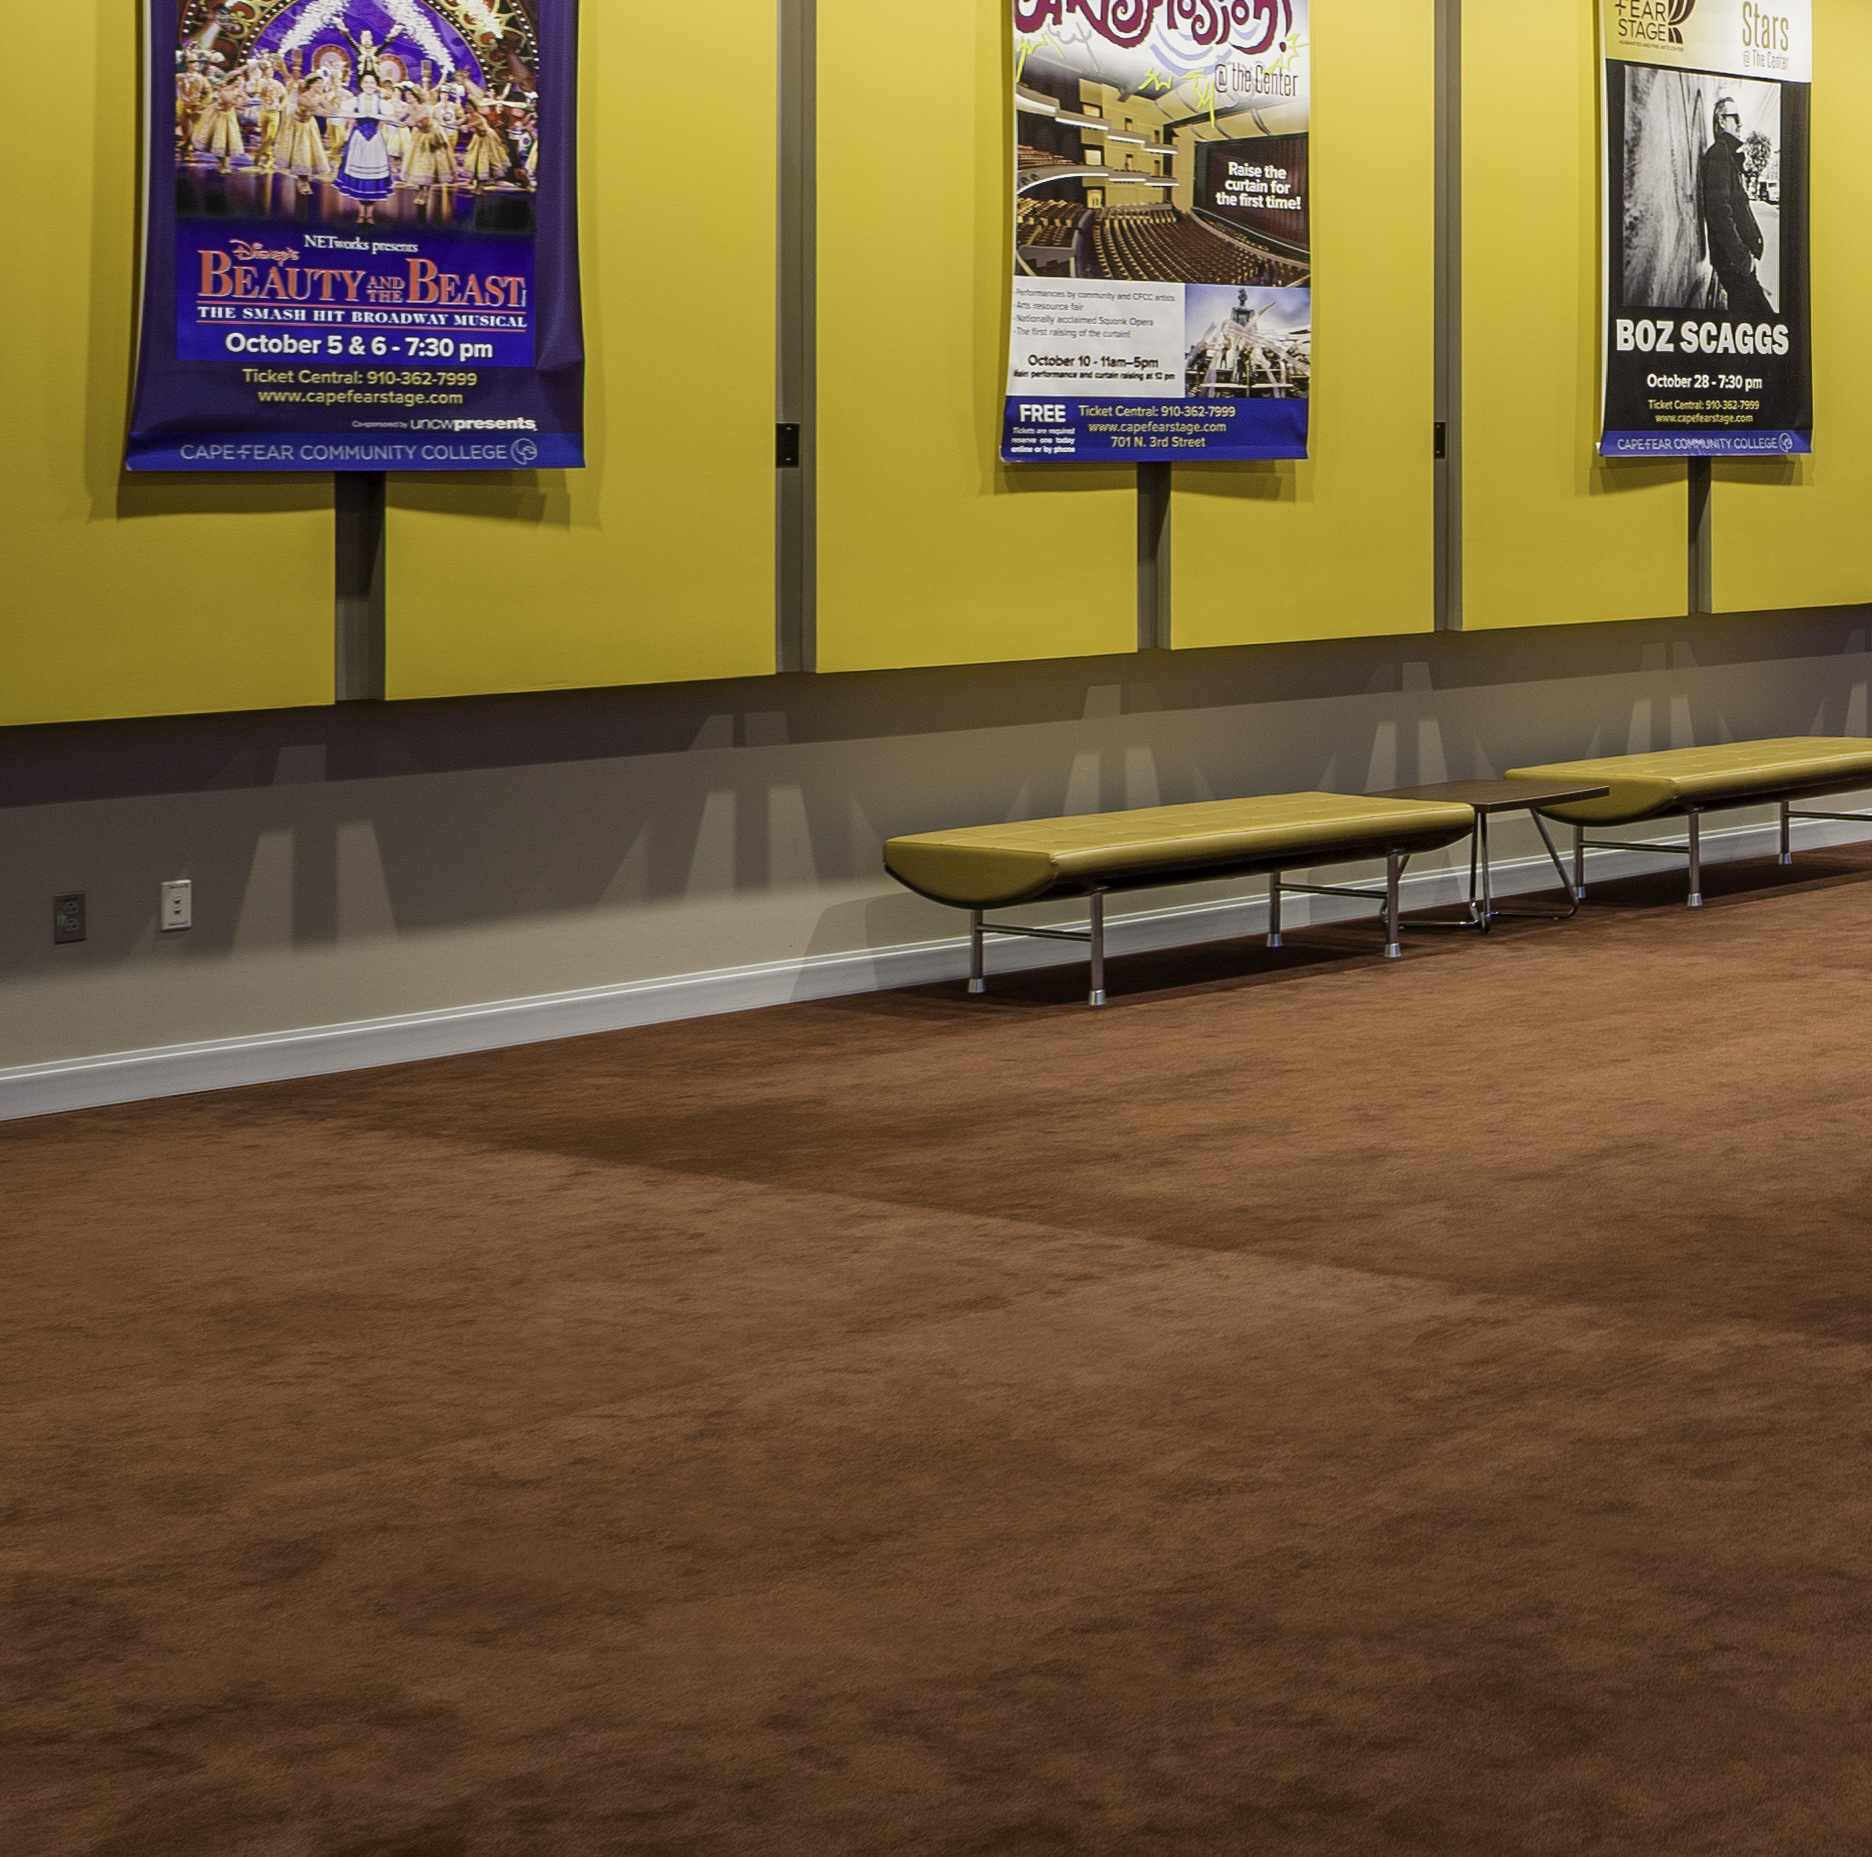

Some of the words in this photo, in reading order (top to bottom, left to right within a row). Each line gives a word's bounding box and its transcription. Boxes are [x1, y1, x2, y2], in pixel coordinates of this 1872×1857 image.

[1618, 18, 1666, 42] STAGE
[1742, 1, 1789, 51] Stars
[1215, 64, 1227, 93] @
[1232, 60, 1251, 92] the
[1255, 63, 1299, 97] Center
[1228, 161, 1262, 177] Raise
[1264, 165, 1287, 179] the
[1225, 179, 1268, 193] curtain
[1271, 180, 1291, 194] for
[1215, 191, 1238, 206] the
[1239, 193, 1264, 208] first
[1265, 196, 1301, 210] time!
[304, 234, 369, 252] NETworks
[372, 240, 418, 254] presents
[366, 275, 405, 290] AND
[1067, 290, 1076, 299] by
[1078, 291, 1115, 301] community
[1033, 303, 1068, 311] resource
[1070, 303, 1084, 311] fair
[197, 306, 236, 319] THE
[242, 308, 306, 322] SMASH
[312, 310, 345, 323] HIT
[351, 311, 448, 326] BROADWAY
[454, 314, 527, 328] MUSICAL
[1057, 316, 1097, 324] acclaimed
[1016, 327, 1029, 335] The
[1032, 327, 1047, 336] first
[1049, 328, 1077, 338] raising
[1079, 329, 1087, 337] of
[1089, 329, 1101, 337] the
[1616, 318, 1675, 352] BOZ
[1680, 321, 1790, 355] SCAGGS
[225, 332, 321, 355] October
[326, 335, 343, 355] 5
[348, 336, 366, 356] &
[371, 336, 388, 356] 6
[405, 337, 455, 358] 7:30
[459, 342, 494, 362] pm
[1028, 354, 1075, 367] October
[1078, 355, 1091, 366] 10
[242, 368, 294, 384] Ticket
[298, 369, 364, 385] Central:
[367, 371, 478, 386] 910-362-7999
[1647, 373, 1692, 389] October
[1693, 375, 1710, 388] 28
[1718, 375, 1743, 389] 7:30
[1745, 377, 1762, 392] pm
[257, 389, 464, 407] www.capefearstage.com
[1648, 399, 1673, 410] Ticket
[1705, 400, 1760, 410] 910-362-7999
[1019, 404, 1067, 422] FREE
[1078, 405, 1113, 417] Ticket
[1115, 405, 1158, 417] Central:
[1161, 406, 1236, 418] 910-362-7999
[1655, 412, 1753, 424] www.capefearstage.com
[1088, 421, 1226, 435] www.capefearstage.com
[1111, 437, 1130, 448] 701
[1134, 437, 1146, 447] N.
[1149, 437, 1169, 448] 3rd
[1171, 437, 1206, 448] Street
[1673, 438, 1732, 450] COMMUNITY
[1734, 437, 1778, 449] COLLEGE
[180, 444, 235, 461] CAPE
[237, 445, 294, 461] FEAR
[300, 445, 416, 461] COMMUNITY
[421, 444, 507, 460] COLLEGE
